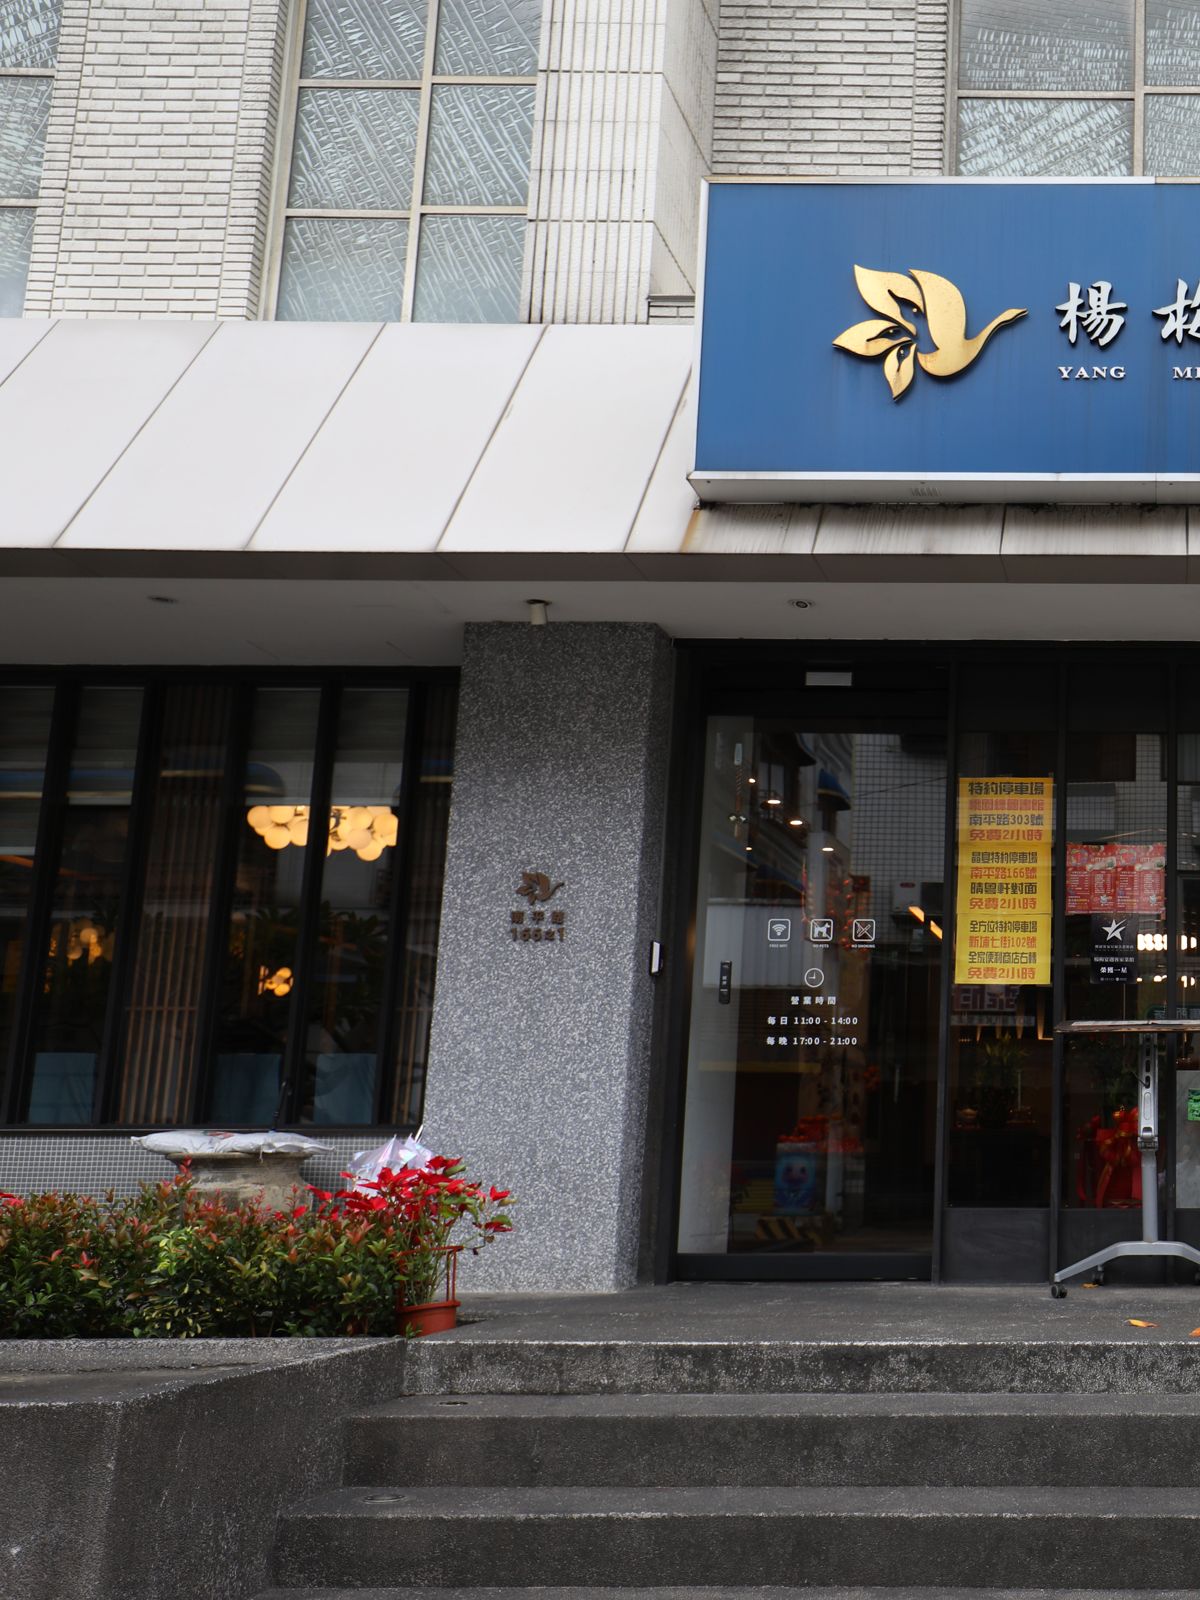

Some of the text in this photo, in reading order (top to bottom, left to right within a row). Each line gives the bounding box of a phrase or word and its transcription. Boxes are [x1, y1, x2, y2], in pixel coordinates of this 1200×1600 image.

[1058, 365, 1127, 380] YANG
[968, 782, 1045, 795] 特約停車場
[969, 814, 1044, 826] 南平路303號
[969, 829, 1043, 841] 免費2小時
[970, 867, 1037, 879] 南平路166號
[969, 898, 1037, 910] 免費2小時
[968, 967, 1036, 979] 免費2小時
[790, 995, 837, 1006] 營業時間
[767, 1016, 788, 1025] 每日
[793, 1017, 821, 1025] 11:00
[831, 1017, 858, 1025] 14:00
[793, 1037, 820, 1045] 17:00
[829, 1037, 857, 1045] 21:00
